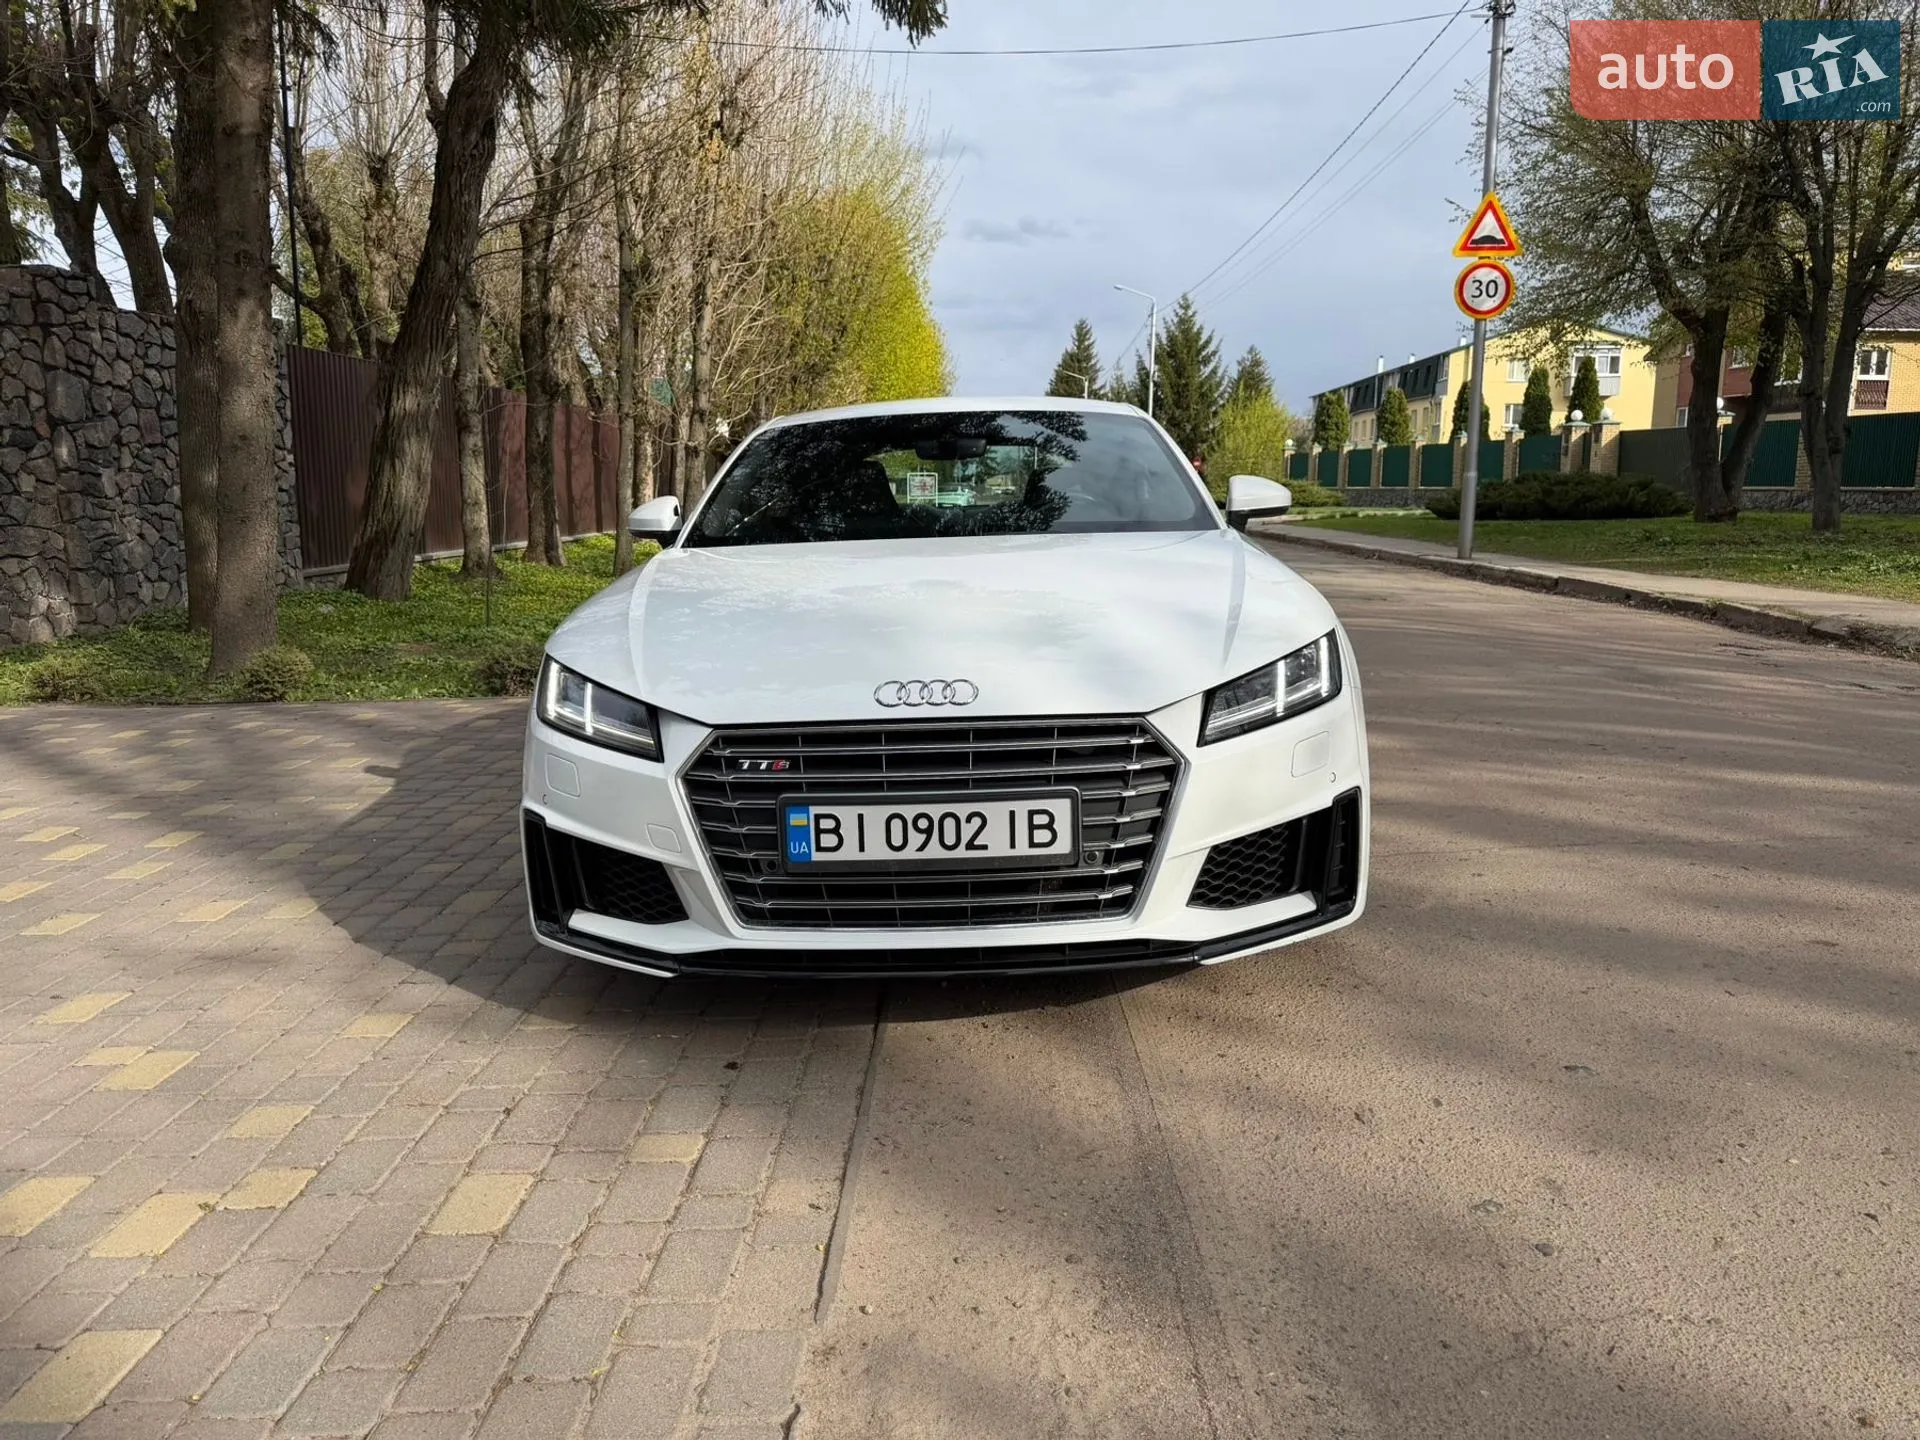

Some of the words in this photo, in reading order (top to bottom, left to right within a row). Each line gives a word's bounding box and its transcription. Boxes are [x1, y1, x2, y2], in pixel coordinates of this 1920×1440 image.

[1471, 279, 1498, 299] 30
[814, 813, 865, 853] BI
[885, 810, 989, 852] 0902
[1009, 808, 1058, 849] IB
[790, 841, 809, 854] UA
